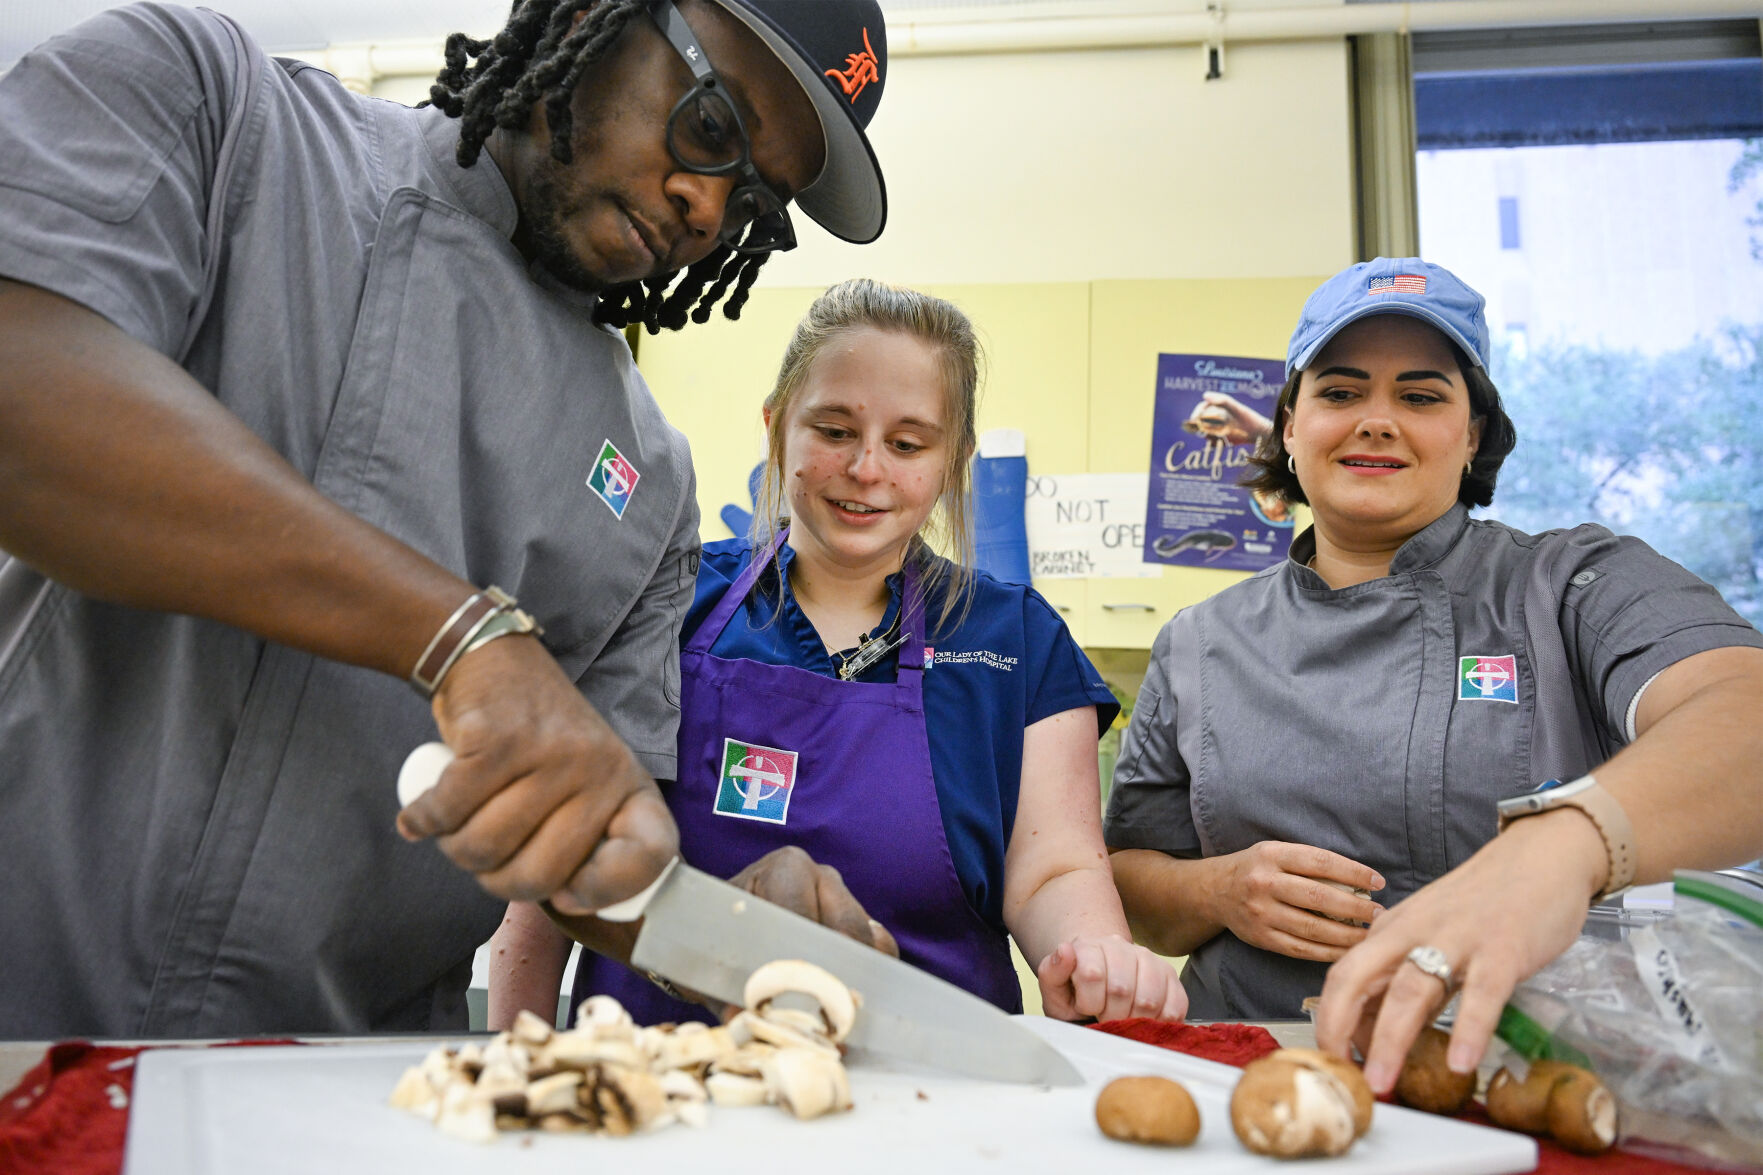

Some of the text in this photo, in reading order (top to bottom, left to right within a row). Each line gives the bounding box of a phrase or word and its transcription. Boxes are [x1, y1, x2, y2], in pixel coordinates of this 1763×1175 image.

[1164, 376, 1219, 392] HARVEST
[1056, 500, 1110, 523] NOT
[1102, 524, 1145, 548] OPE
[934, 656, 1013, 672] CHILDREN'S HOSPITAL
[984, 650, 998, 660] THE
[998, 655, 1018, 665] LAKE
